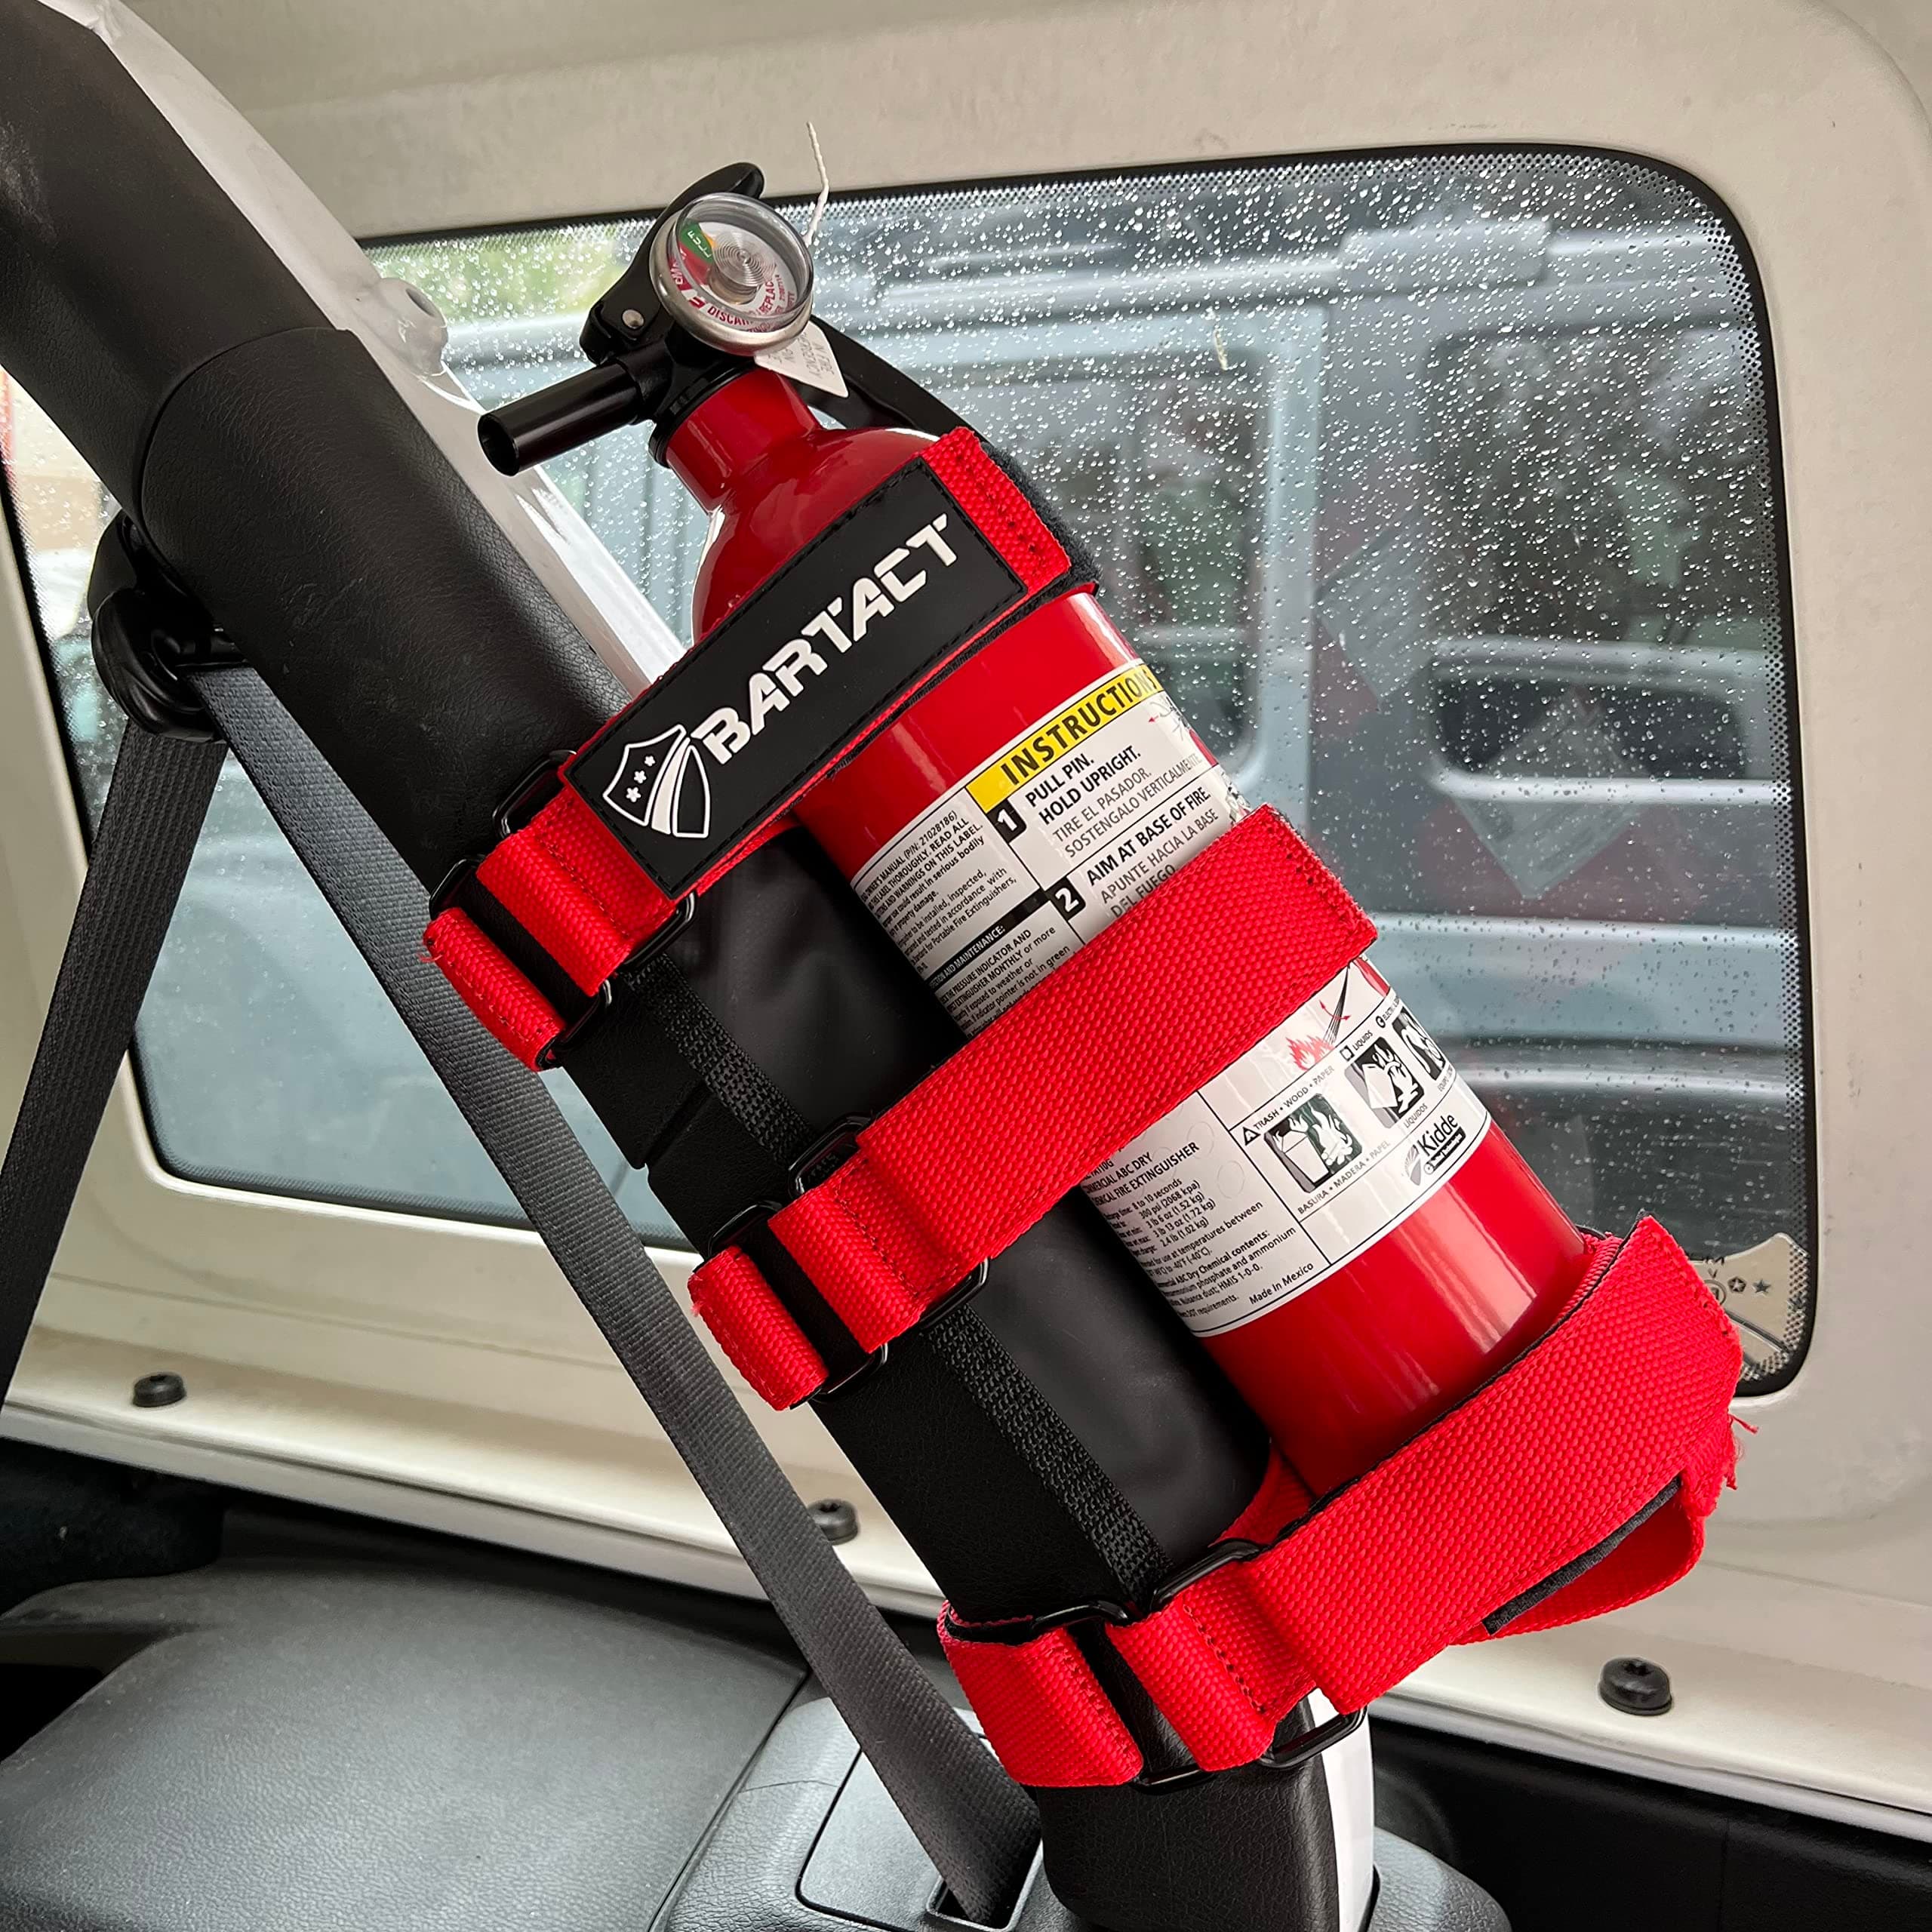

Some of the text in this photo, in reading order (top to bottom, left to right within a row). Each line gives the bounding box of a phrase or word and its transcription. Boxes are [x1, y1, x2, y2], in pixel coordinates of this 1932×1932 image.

[688, 230, 712, 258] FULL
[690, 513, 958, 765] BARTACT
[1000, 669, 1158, 786] INSTRUCTIONS
[1025, 753, 1094, 807] PULL PIN.
[1038, 746, 1141, 825] HOLD UPRIGHT.
[1053, 768, 1152, 841] TIRE EL PASADOR.
[879, 857, 906, 881] MANUAL
[919, 811, 957, 846] 21028186)
[998, 809, 1017, 831] 1
[1065, 797, 1140, 857] SOSTENGALO
[1087, 787, 1211, 886] AIM AT BASE OF FIRE.
[888, 849, 931, 888] THOROUGHLY.
[929, 831, 952, 852] READ
[952, 818, 969, 834] ALL
[894, 868, 925, 898] WARNINGS
[924, 858, 937, 872] ON
[935, 844, 954, 861] THIS
[952, 824, 983, 848] LABEL.
[909, 883, 927, 900] result
[924, 878, 934, 887] in
[933, 857, 959, 881] serious
[957, 836, 984, 859] bodily
[1101, 808, 1218, 904] APUNTE HACIA LA BASE
[913, 891, 939, 912] damage.
[921, 899, 950, 924] installed,
[947, 869, 986, 901] inspected,
[924, 919, 942, 937] tested
[939, 915, 949, 924] in
[946, 885, 986, 918] accordance
[986, 869, 1007, 885] with
[931, 925, 955, 946] Portable
[952, 915, 967, 928] Fire
[964, 878, 1017, 918] Extinguishers,
[1055, 888, 1079, 912] 2
[1110, 896, 1138, 918] DEL
[954, 926, 1005, 968] MAINTENANCE:
[975, 943, 1014, 976] INDICATOR
[1013, 930, 1031, 948] AND
[987, 949, 1023, 980] MONTHLY
[1023, 943, 1032, 953] or
[1033, 928, 1056, 946] more
[988, 987, 997, 995] to
[995, 965, 1023, 989] weather
[1024, 958, 1032, 968] or
[995, 984, 1018, 1006] pointer
[1017, 980, 1025, 988] is
[1023, 970, 1038, 983] not
[1036, 964, 1047, 973] in
[1046, 946, 1070, 968] green
[1254, 1109, 1279, 1130] TRASH
[1283, 1087, 1309, 1107] WOOD
[1312, 1066, 1334, 1085] PAPER
[1417, 1115, 1458, 1156] Kidde
[1113, 1183, 1132, 1198] FIRE
[1128, 1142, 1199, 1190] EXTINGUISHER
[1115, 1164, 1134, 1180] ABC
[1131, 1152, 1152, 1171] DRY
[1144, 1194, 1154, 1203] 10
[1153, 1179, 1182, 1199] seconds
[1297, 1140, 1390, 1214] BASURA MADERA PAPEL
[1139, 1180, 1200, 1219] 300 psi (2068 kpa)
[1158, 1214, 1164, 1223] 6
[1164, 1211, 1174, 1220] oz
[1171, 1200, 1191, 1216] (1.52
[1189, 1191, 1204, 1204] kg)
[1164, 1223, 1174, 1231] 13
[1174, 1219, 1184, 1227] oz
[1182, 1207, 1202, 1223] (1.72
[1200, 1198, 1216, 1211] kg)
[1169, 1234, 1179, 1242] lb
[1177, 1224, 1196, 1239] (1.02
[1194, 1216, 1209, 1229] kg)
[1177, 1226, 1226, 1255] temperatures
[1223, 1202, 1263, 1229] between
[1186, 1270, 1200, 1279] Dry
[1198, 1251, 1232, 1274] Chemical
[1232, 1231, 1267, 1257] contents:
[1196, 1267, 1232, 1290] phosphate
[1232, 1256, 1248, 1270] and
[1248, 1228, 1296, 1261] ammonium
[1238, 1263, 1263, 1279] 1-0-0.
[1249, 1289, 1272, 1304] Made
[1281, 1263, 1313, 1286] Mexico
